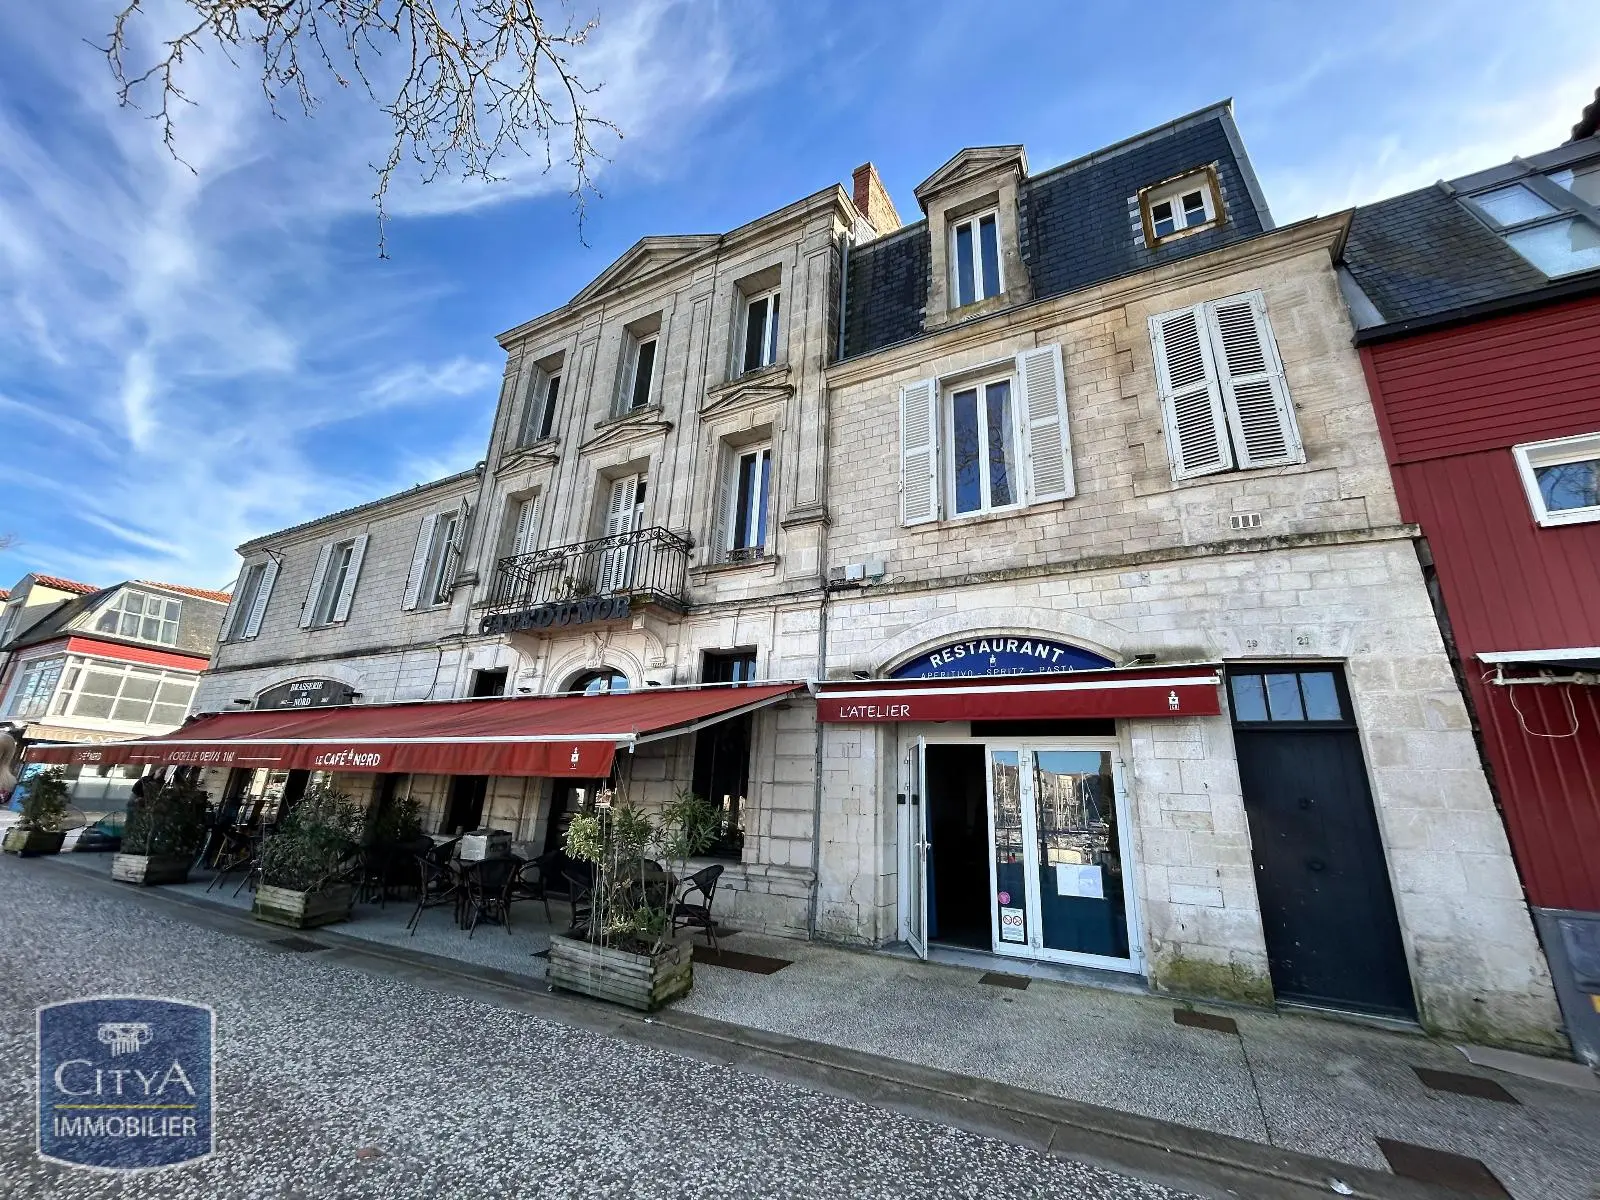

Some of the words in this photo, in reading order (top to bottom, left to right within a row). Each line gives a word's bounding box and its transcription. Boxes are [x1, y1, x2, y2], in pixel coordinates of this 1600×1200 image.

[929, 638, 1065, 669] RESTAURANT
[986, 667, 1025, 678] SPRITZ
[1039, 664, 1074, 674] PASTA
[290, 682, 323, 691] BRASSERIE
[293, 697, 311, 706] NORD
[840, 704, 911, 718] L'ATELIER
[323, 749, 348, 766] CAFÉ
[352, 752, 381, 767] NORD
